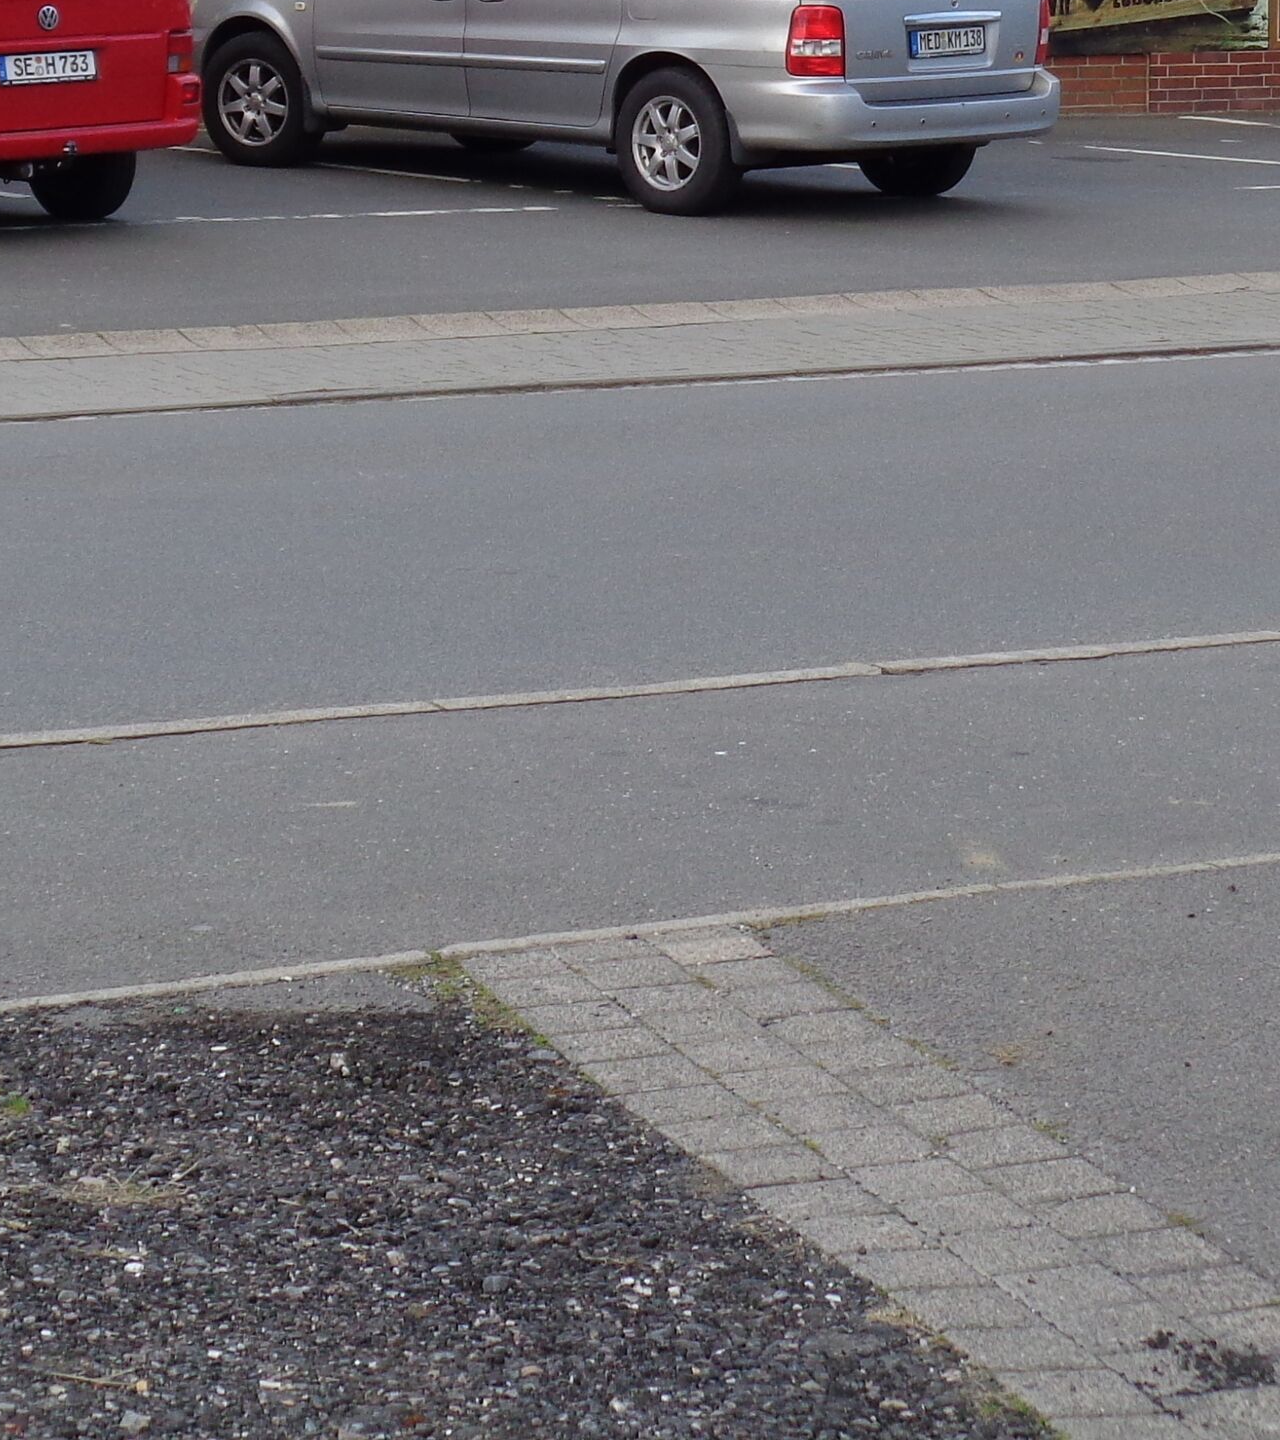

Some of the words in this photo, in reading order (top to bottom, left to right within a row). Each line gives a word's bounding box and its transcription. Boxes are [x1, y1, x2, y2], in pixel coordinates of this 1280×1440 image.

[919, 31, 941, 51] MED
[947, 30, 962, 49] KM
[963, 29, 982, 48] 138
[13, 57, 35, 76] SE
[44, 55, 57, 75] H
[59, 54, 89, 74] 733
